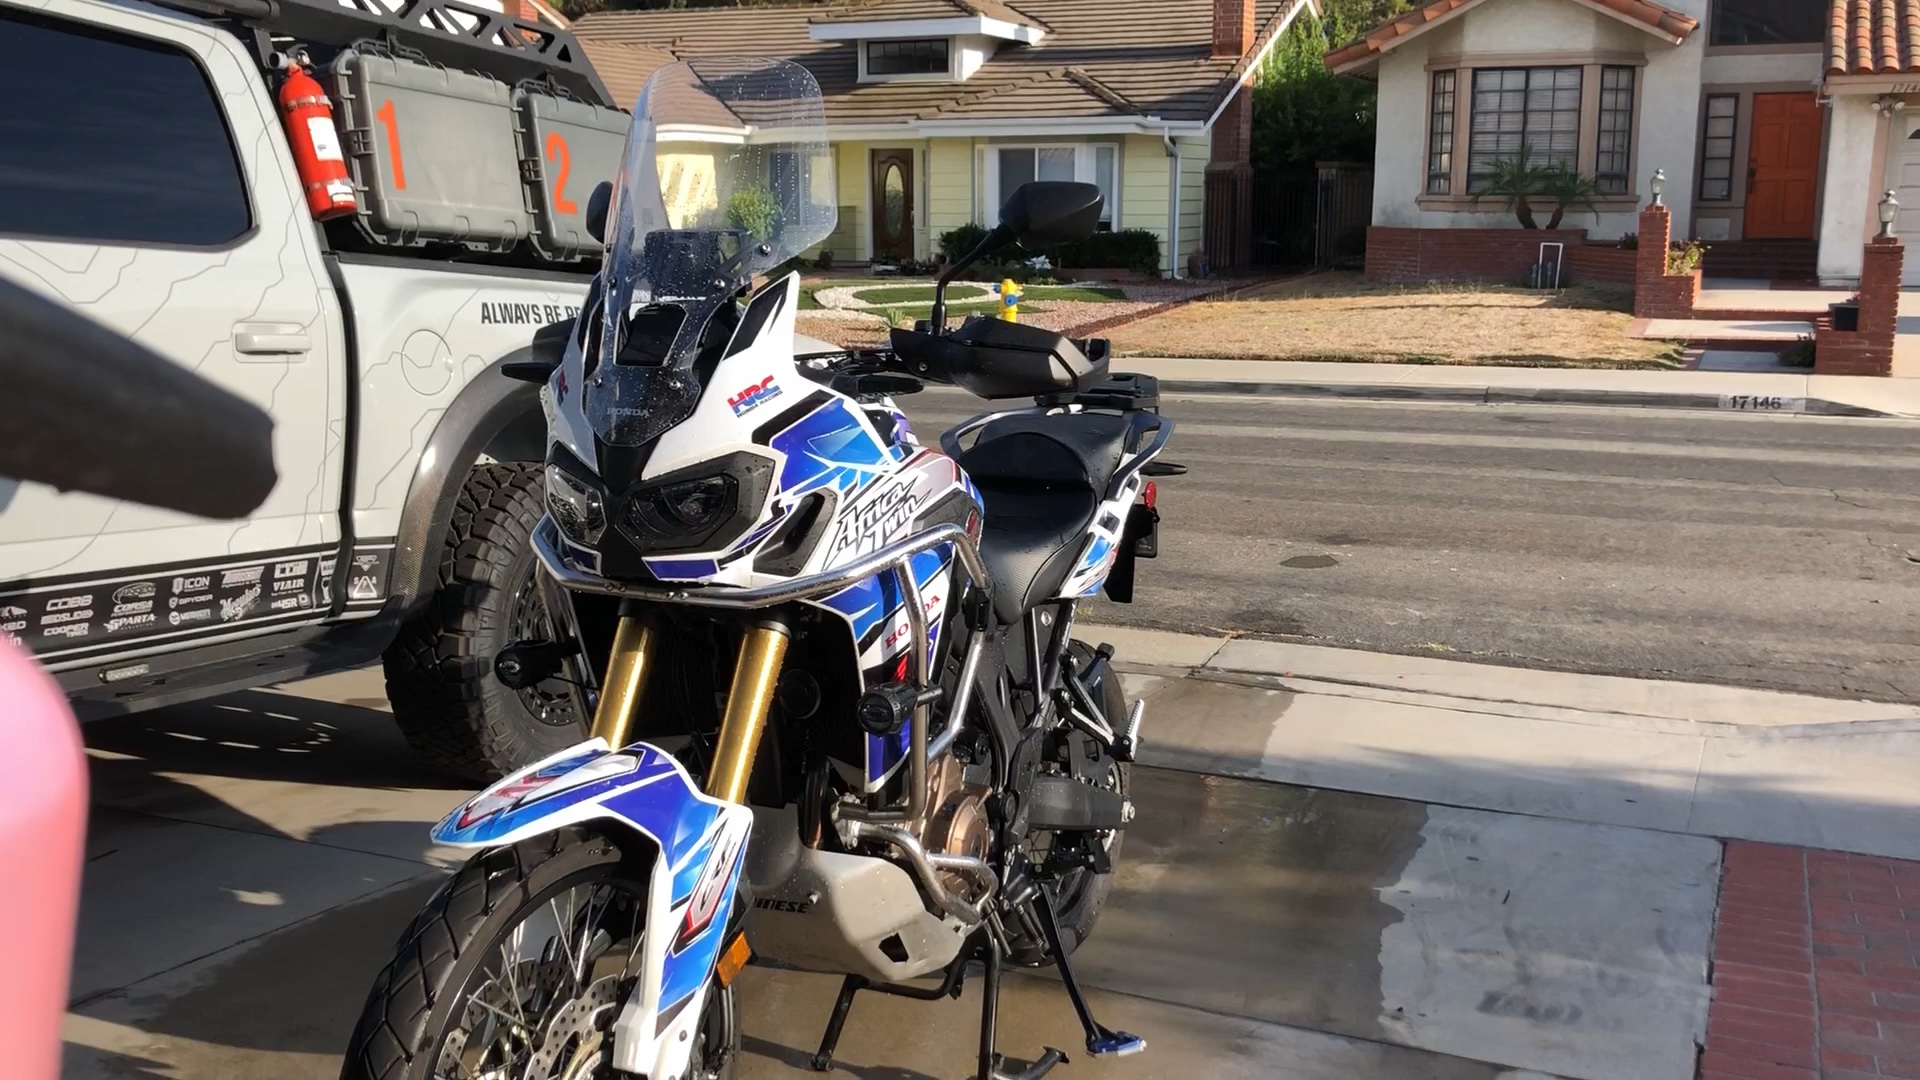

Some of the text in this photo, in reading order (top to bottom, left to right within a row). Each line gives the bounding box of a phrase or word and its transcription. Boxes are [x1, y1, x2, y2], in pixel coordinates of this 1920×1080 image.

[376, 98, 406, 191] 1
[545, 131, 578, 215] 2
[481, 302, 542, 324] ALWAYS
[727, 374, 781, 415] HRC
[759, 389, 783, 405] RACING
[1730, 395, 1781, 409] 17146
[606, 407, 650, 417] HONDA
[829, 476, 918, 556] Africa
[862, 488, 932, 554] Twin
[184, 576, 210, 589] ICON
[273, 579, 305, 592] VIAIR
[46, 595, 93, 611] COBB
[114, 600, 153, 613] CORSA
[179, 594, 213, 605] SPYDER
[43, 622, 90, 636] COOPER
[105, 614, 157, 632] SPARTA
[885, 595, 940, 649] HODA
